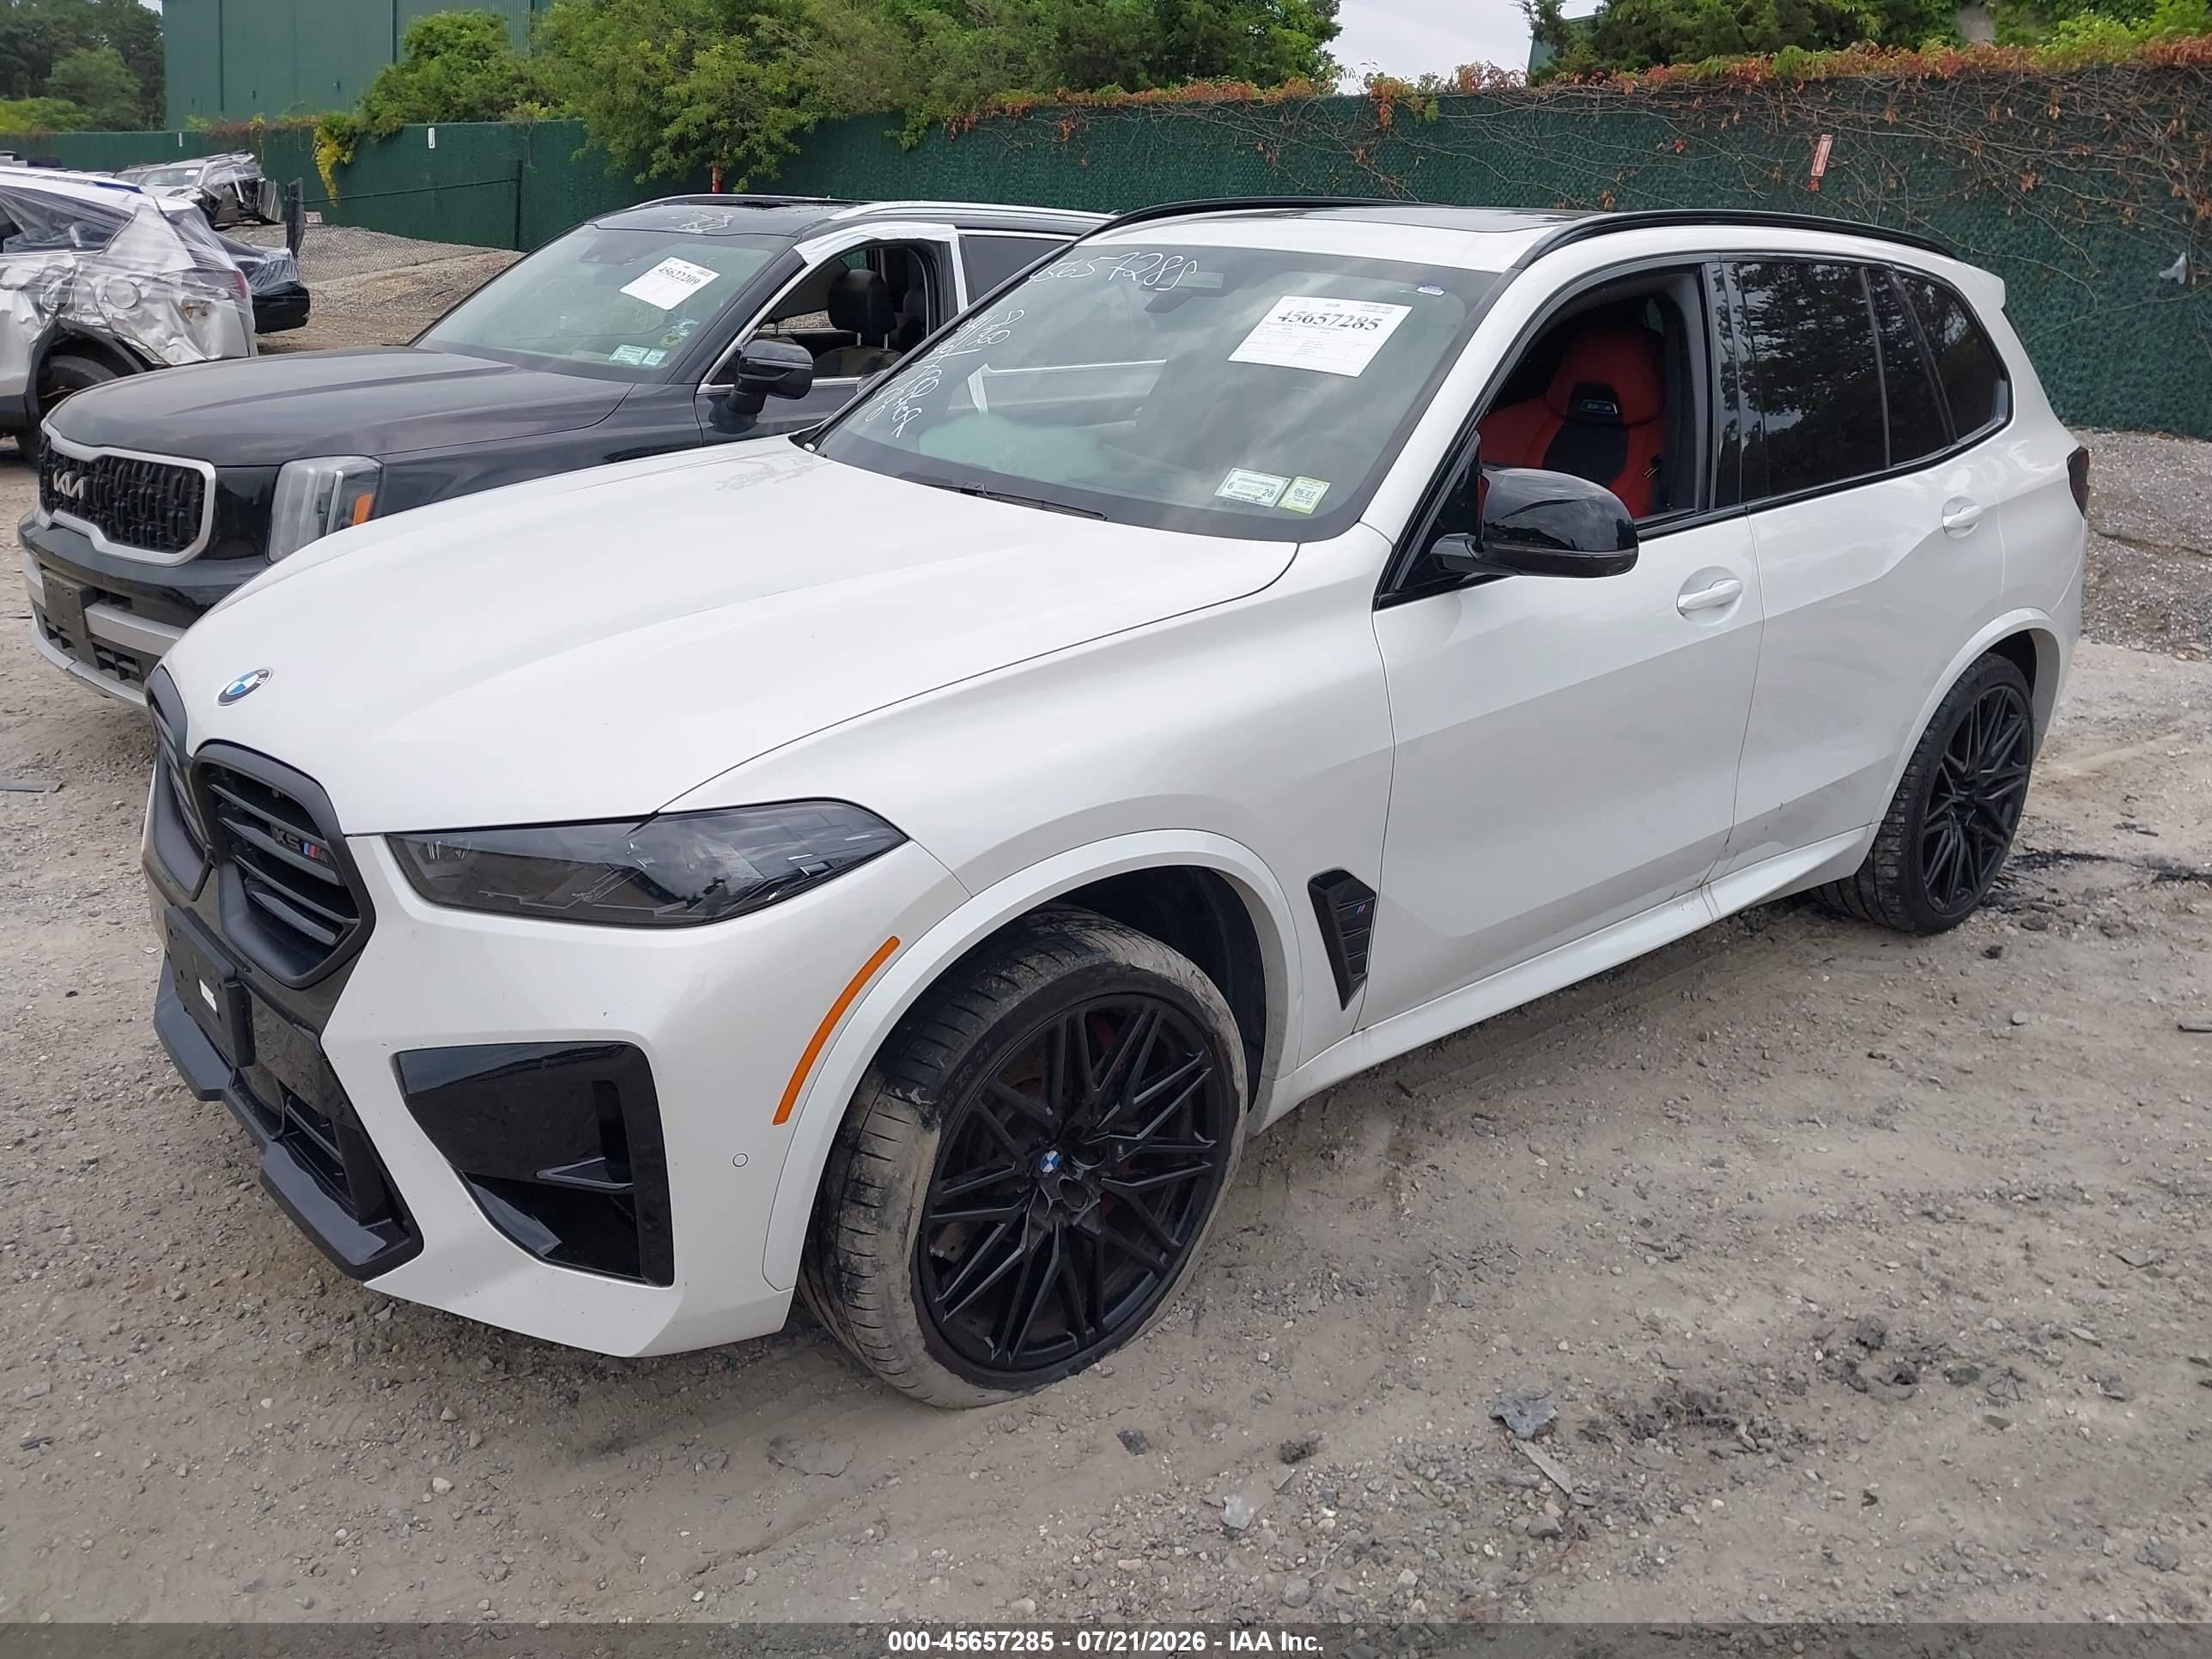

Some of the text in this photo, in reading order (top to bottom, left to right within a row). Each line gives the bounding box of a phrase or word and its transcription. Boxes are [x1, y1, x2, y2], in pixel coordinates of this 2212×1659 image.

[1277, 310, 1383, 331] 45657285
[53, 468, 83, 500] KIA
[1261, 489, 1275, 498] 28
